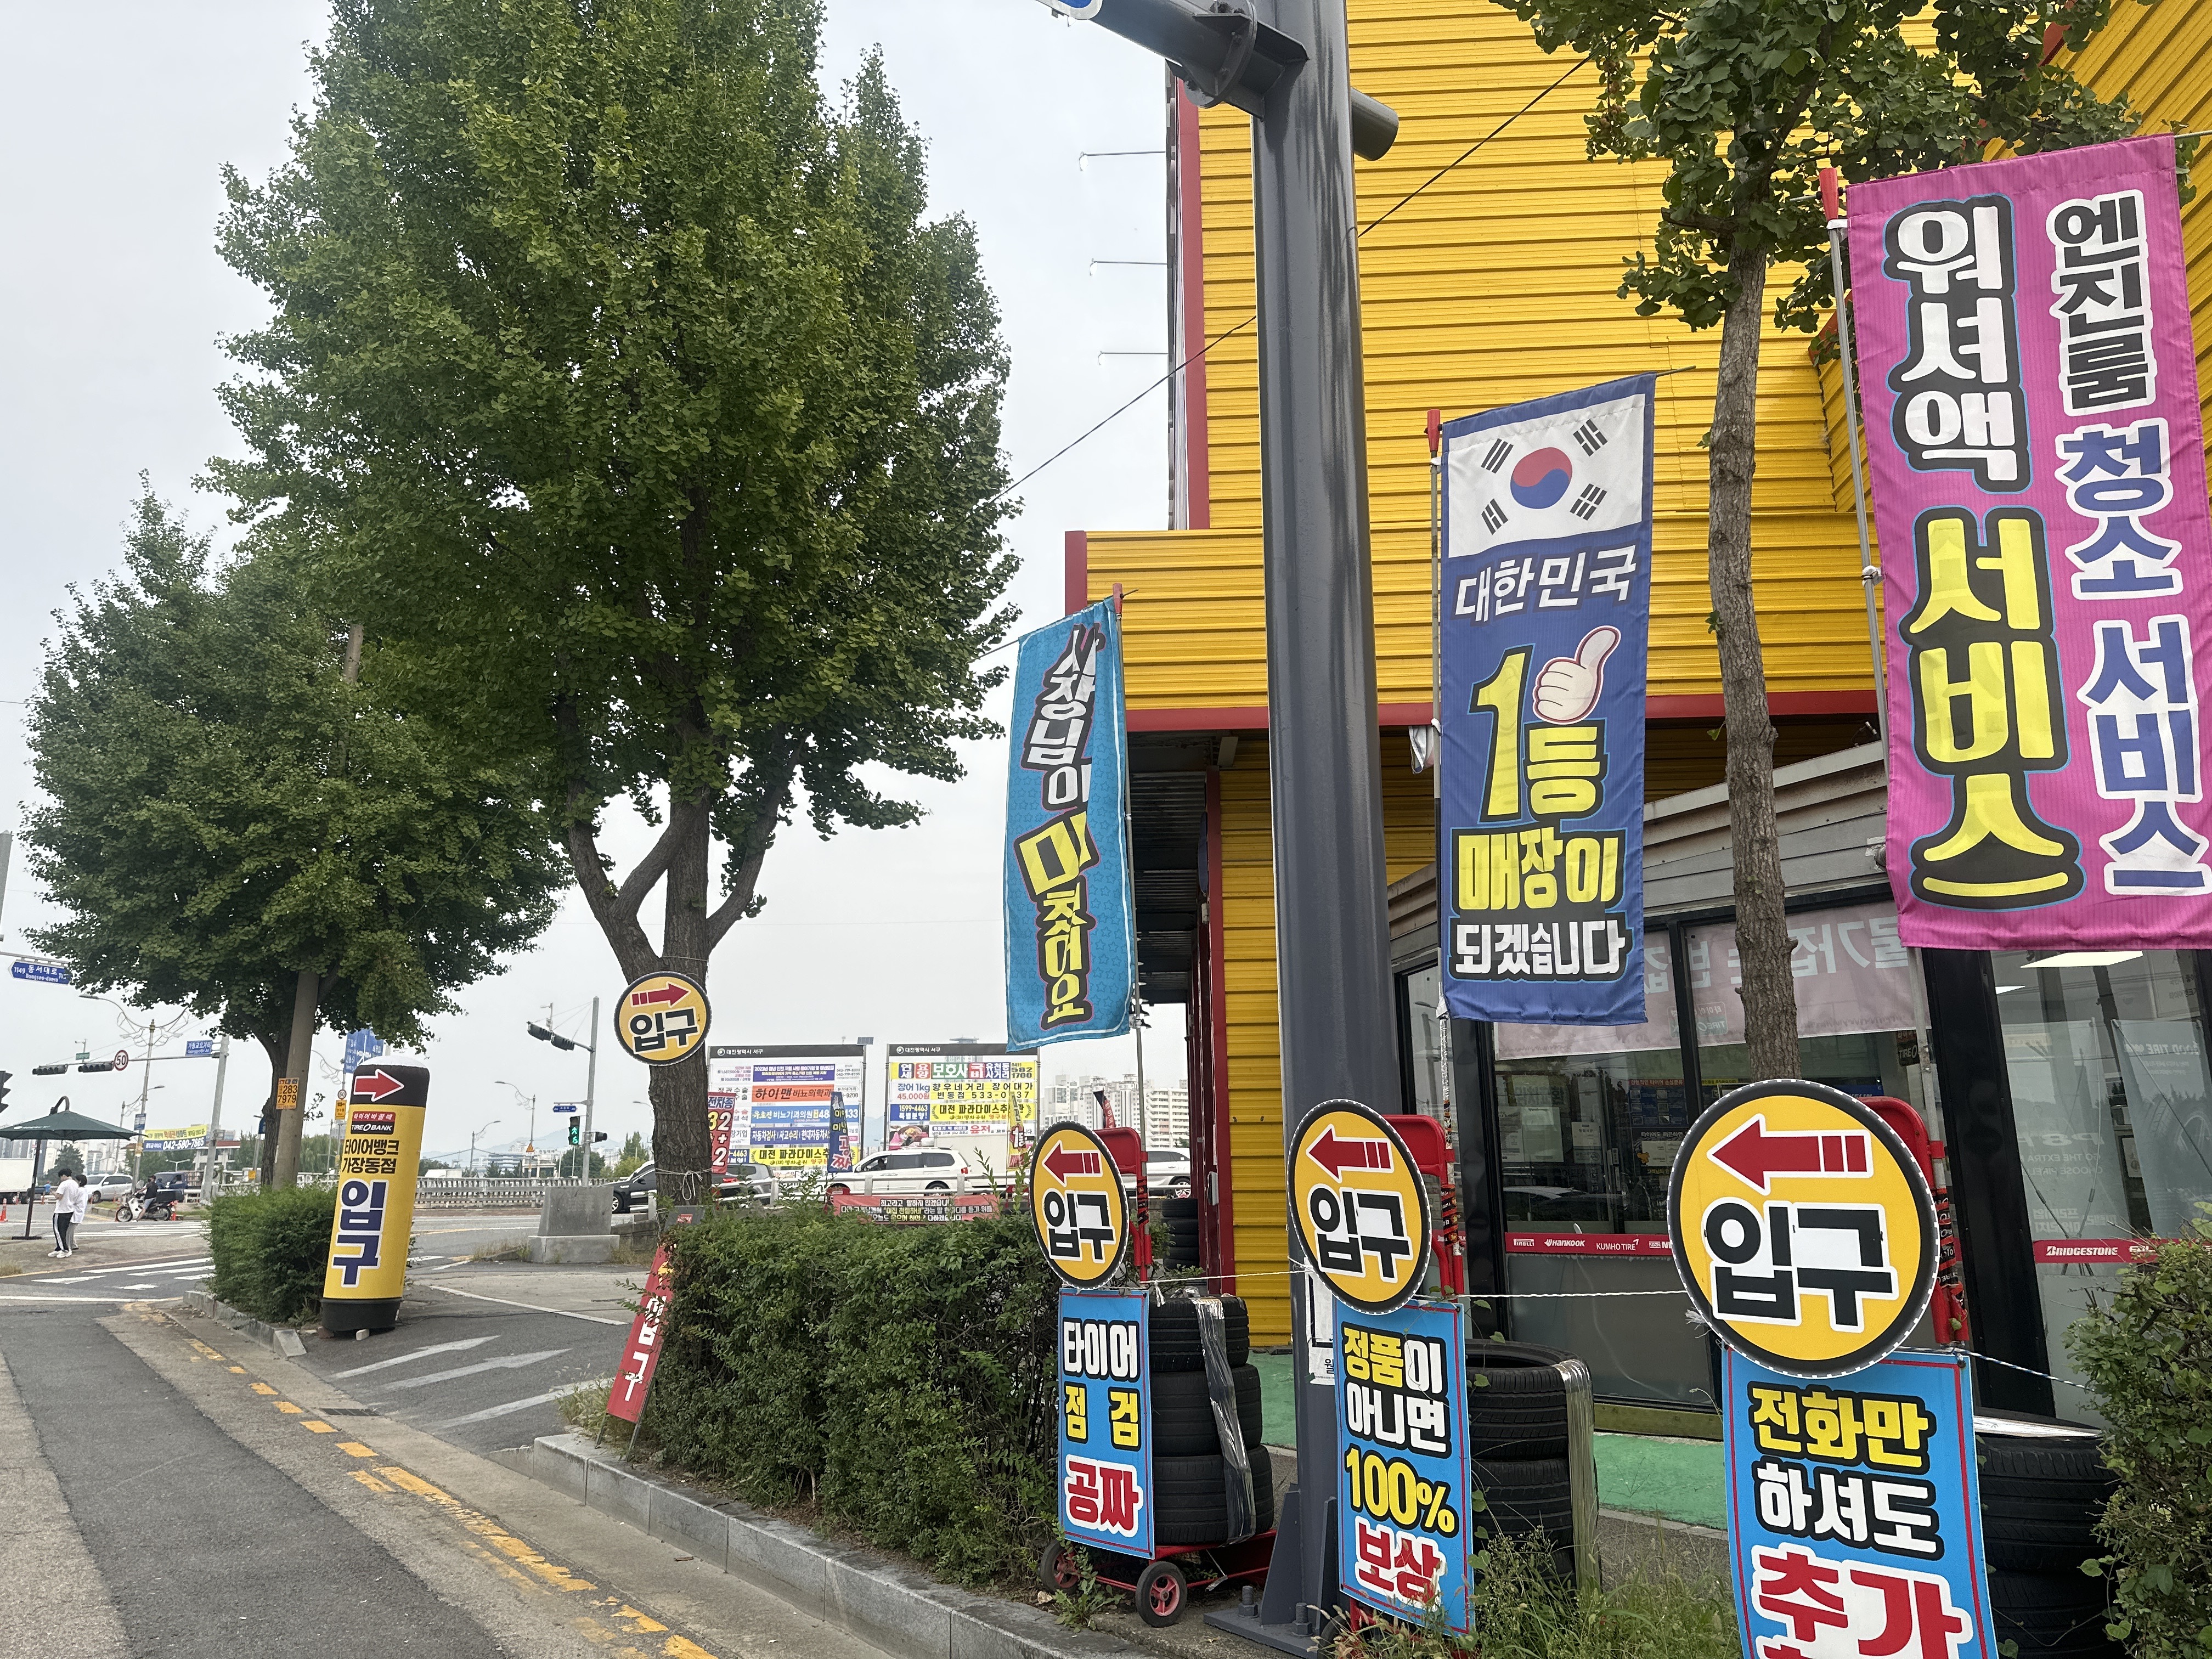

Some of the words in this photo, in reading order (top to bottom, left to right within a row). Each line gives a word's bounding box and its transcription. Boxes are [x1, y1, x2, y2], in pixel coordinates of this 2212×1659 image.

[2054, 195, 2149, 410] 엔진룸
[1897, 206, 2018, 481] 워셔액
[2063, 425, 2175, 594] 청소
[1454, 545, 1637, 622] 대한민국
[1029, 627, 1097, 808] 사장님이
[1474, 651, 1602, 817] 1등
[1909, 518, 2069, 898] 서비스
[2085, 620, 2205, 888] 서비스
[1458, 830, 1620, 912] 매장이
[28, 964, 57, 975] 동서대로
[1455, 919, 1625, 975] 되겠습니다
[630, 1008, 698, 1052] 입구
[115, 1054, 126, 1066] 50
[898, 1083, 914, 1091] 장어
[915, 1083, 930, 1093] 1kg
[900, 1063, 912, 1079] 연세
[917, 1063, 929, 1079] 요양
[933, 1063, 968, 1079] 보호사
[970, 1063, 984, 1079] 국비
[985, 1070, 1009, 1079] 사거리
[986, 1063, 1010, 1071] 유천동
[277, 1094, 297, 1103] 7979
[283, 1085, 297, 1094] 283
[708, 1097, 734, 1109] 전차종
[755, 1088, 791, 1100] 하이맨
[899, 1104, 928, 1113] 1599-4463
[939, 1104, 955, 1114] 대전
[958, 1103, 1025, 1114] 파라다이스추관
[344, 1138, 399, 1155] 타이어뱅크
[752, 1130, 776, 1142] 자동차검사
[778, 1129, 798, 1141] 사고수리
[759, 1149, 776, 1160] 대전
[342, 1157, 397, 1174] 가장동점
[332, 1181, 386, 1286] 입구
[1044, 1193, 1114, 1261] 입구
[1310, 1187, 1410, 1279] 입구
[1513, 1238, 1535, 1247] PIRELLI
[1596, 1242, 1621, 1251] KUMHO
[1621, 1243, 1637, 1251] TIRE
[2045, 1245, 2119, 1256] BRIDGESTONE
[1705, 1202, 1893, 1327] 입구
[1064, 1321, 1138, 1378] 타이어
[1343, 1328, 1443, 1395] 정품이
[1346, 1381, 1447, 1453] 아니면
[1752, 1386, 1929, 1468] 전화만
[1068, 1460, 1139, 1531] 공짜
[1346, 1447, 1456, 1534] 100%
[1757, 1462, 1938, 1554] 하셔도
[1357, 1522, 1443, 1606] 보상
[1758, 1551, 1963, 1659] 추가
